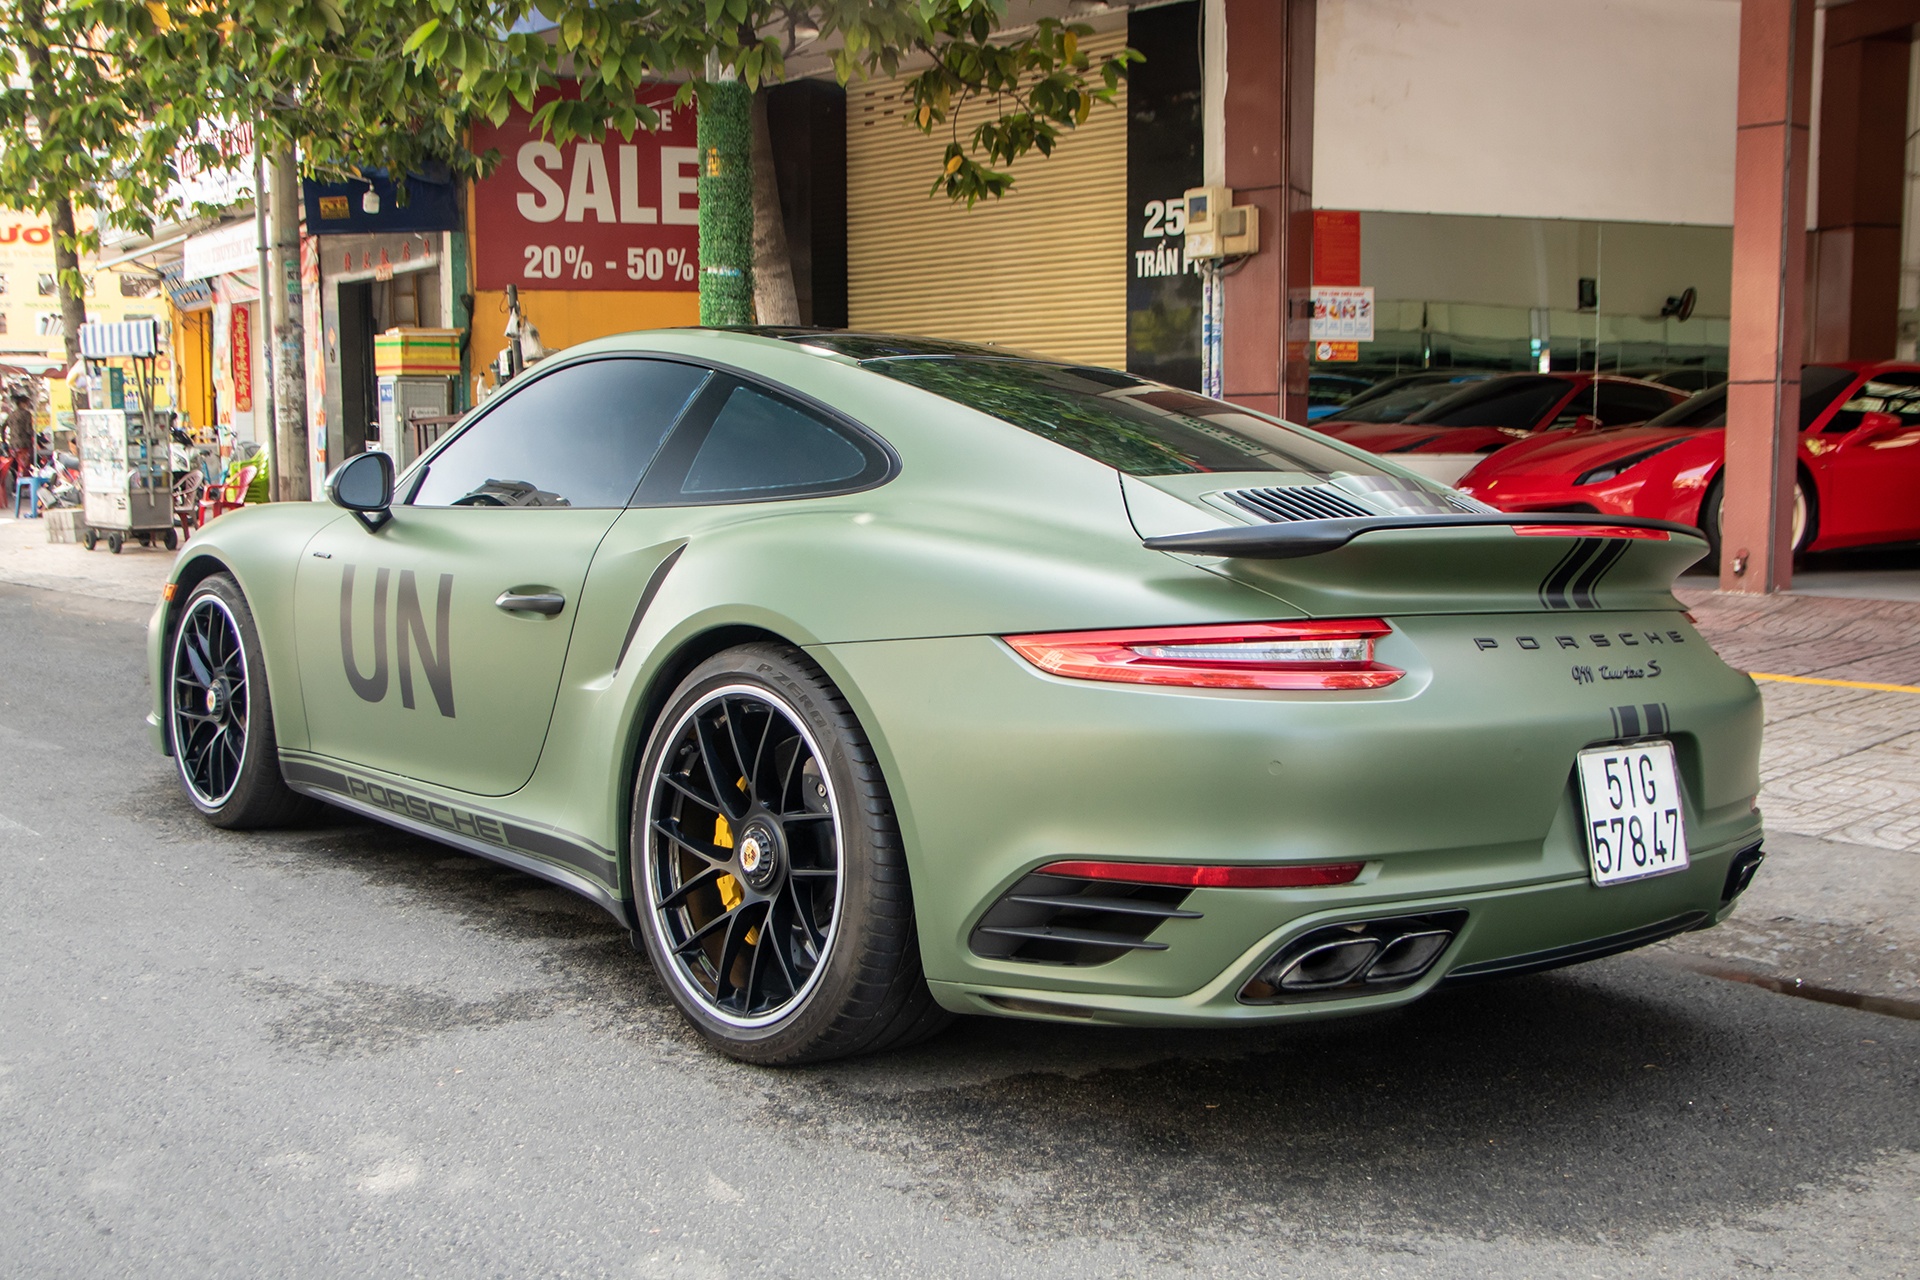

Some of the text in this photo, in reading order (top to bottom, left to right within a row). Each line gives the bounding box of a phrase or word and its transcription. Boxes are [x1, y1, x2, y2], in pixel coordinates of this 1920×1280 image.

[516, 140, 700, 226] SALE
[523, 244, 593, 280] 20%
[626, 246, 694, 282] 50%
[340, 563, 456, 719] UN
[1473, 631, 1685, 652] PORSCHE
[1571, 659, 1662, 685] 911 Turbo S
[347, 775, 504, 843] PORSCHE
[1603, 753, 1657, 811] 51G
[1592, 808, 1678, 874] 578.47
